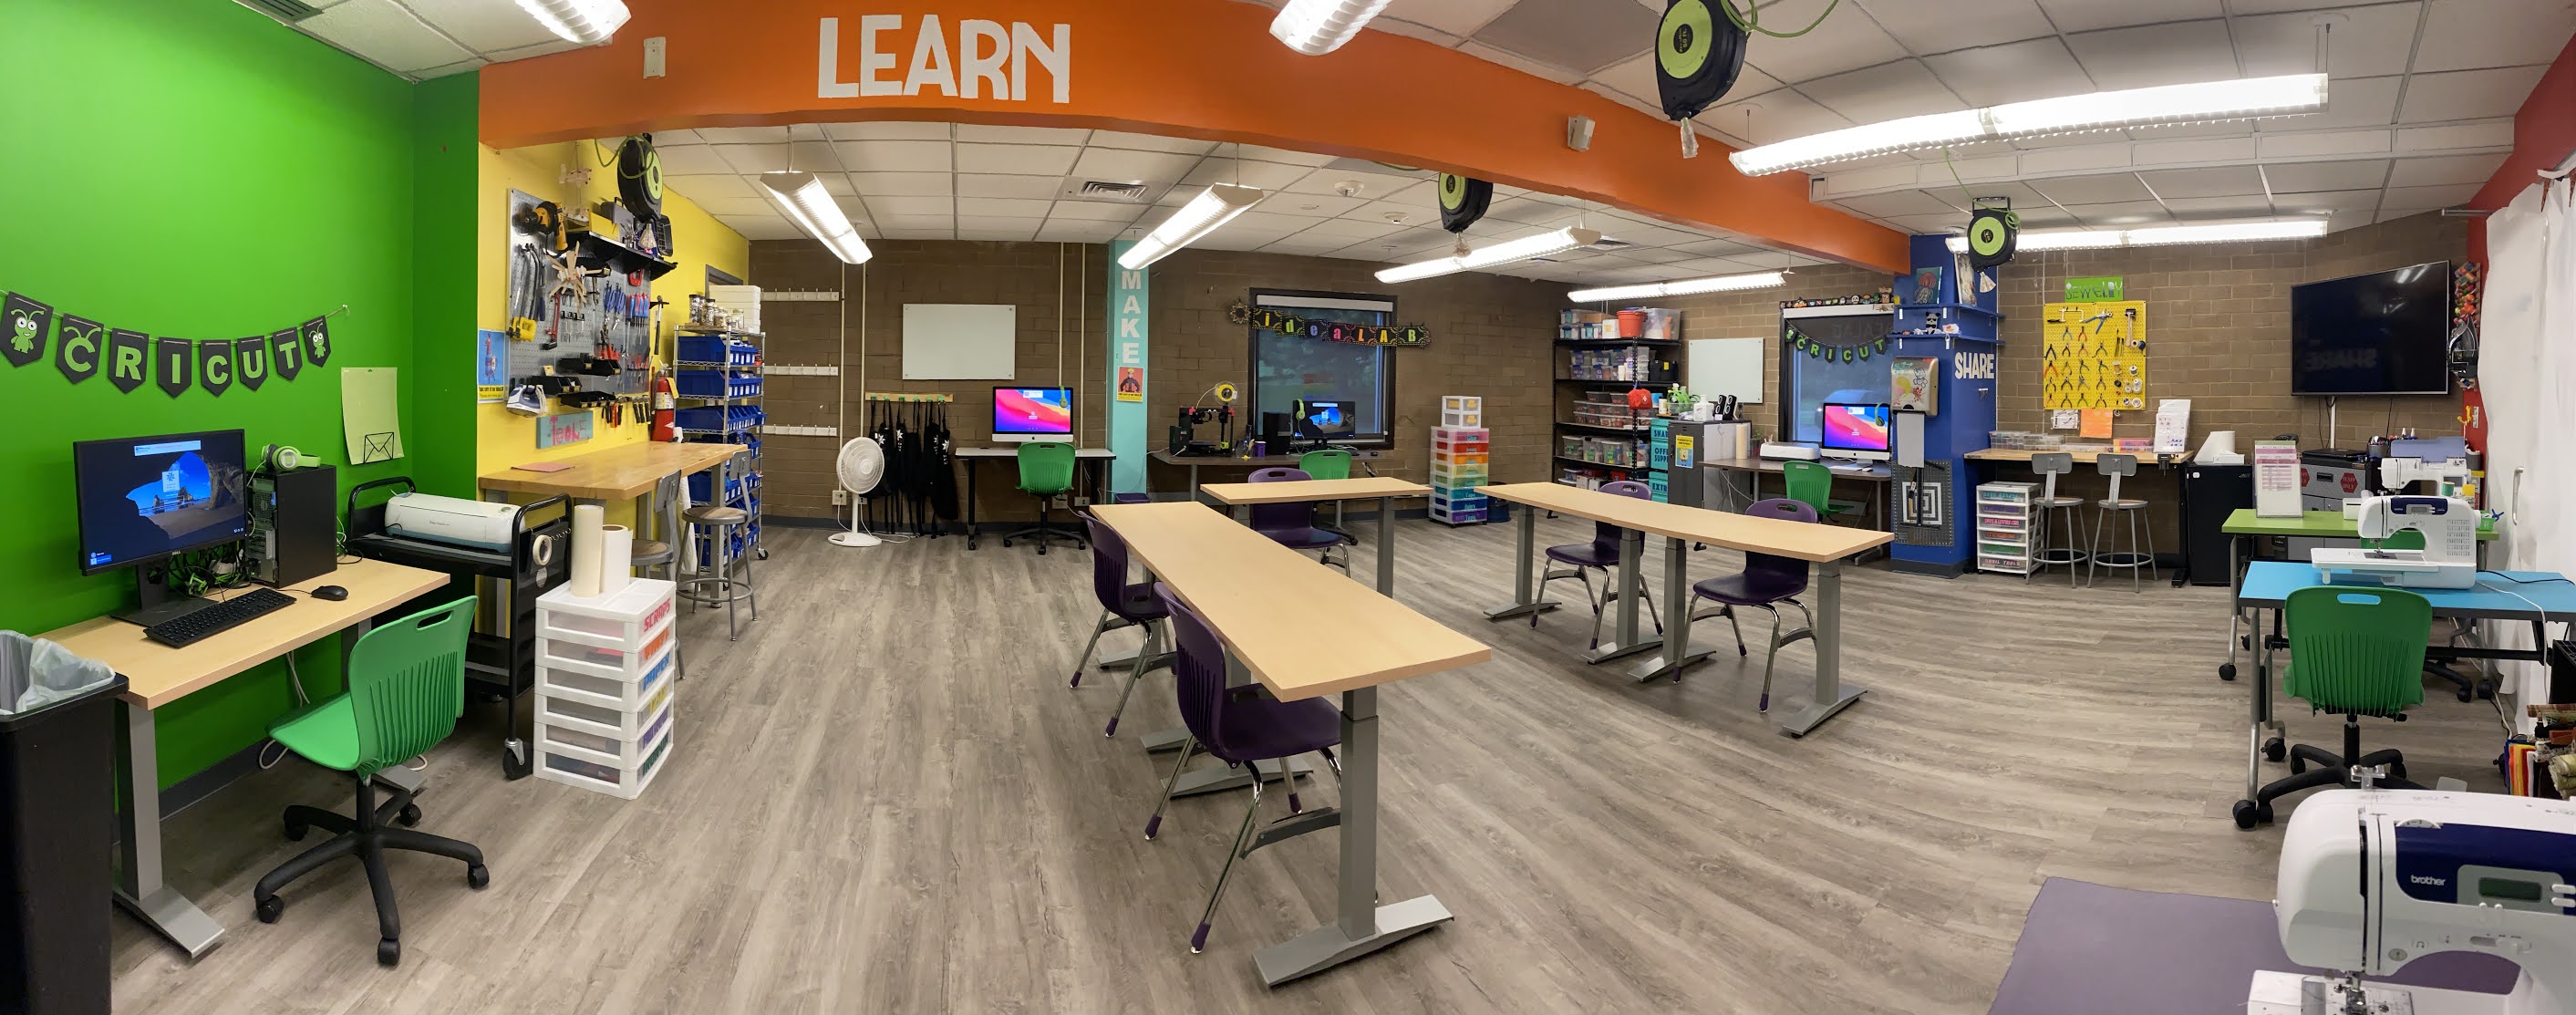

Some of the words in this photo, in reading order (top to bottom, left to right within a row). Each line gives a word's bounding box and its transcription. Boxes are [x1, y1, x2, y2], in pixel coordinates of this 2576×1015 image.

[818, 15, 1071, 103] LEARN
[1121, 270, 1142, 364] MAKE
[63, 327, 298, 384] CRICUT
[1796, 337, 1884, 361] CRICUT
[1955, 352, 1994, 379] SHARE
[644, 597, 671, 633] SCRAPS
[643, 651, 670, 692] PAPER
[2410, 874, 2447, 886] brother
